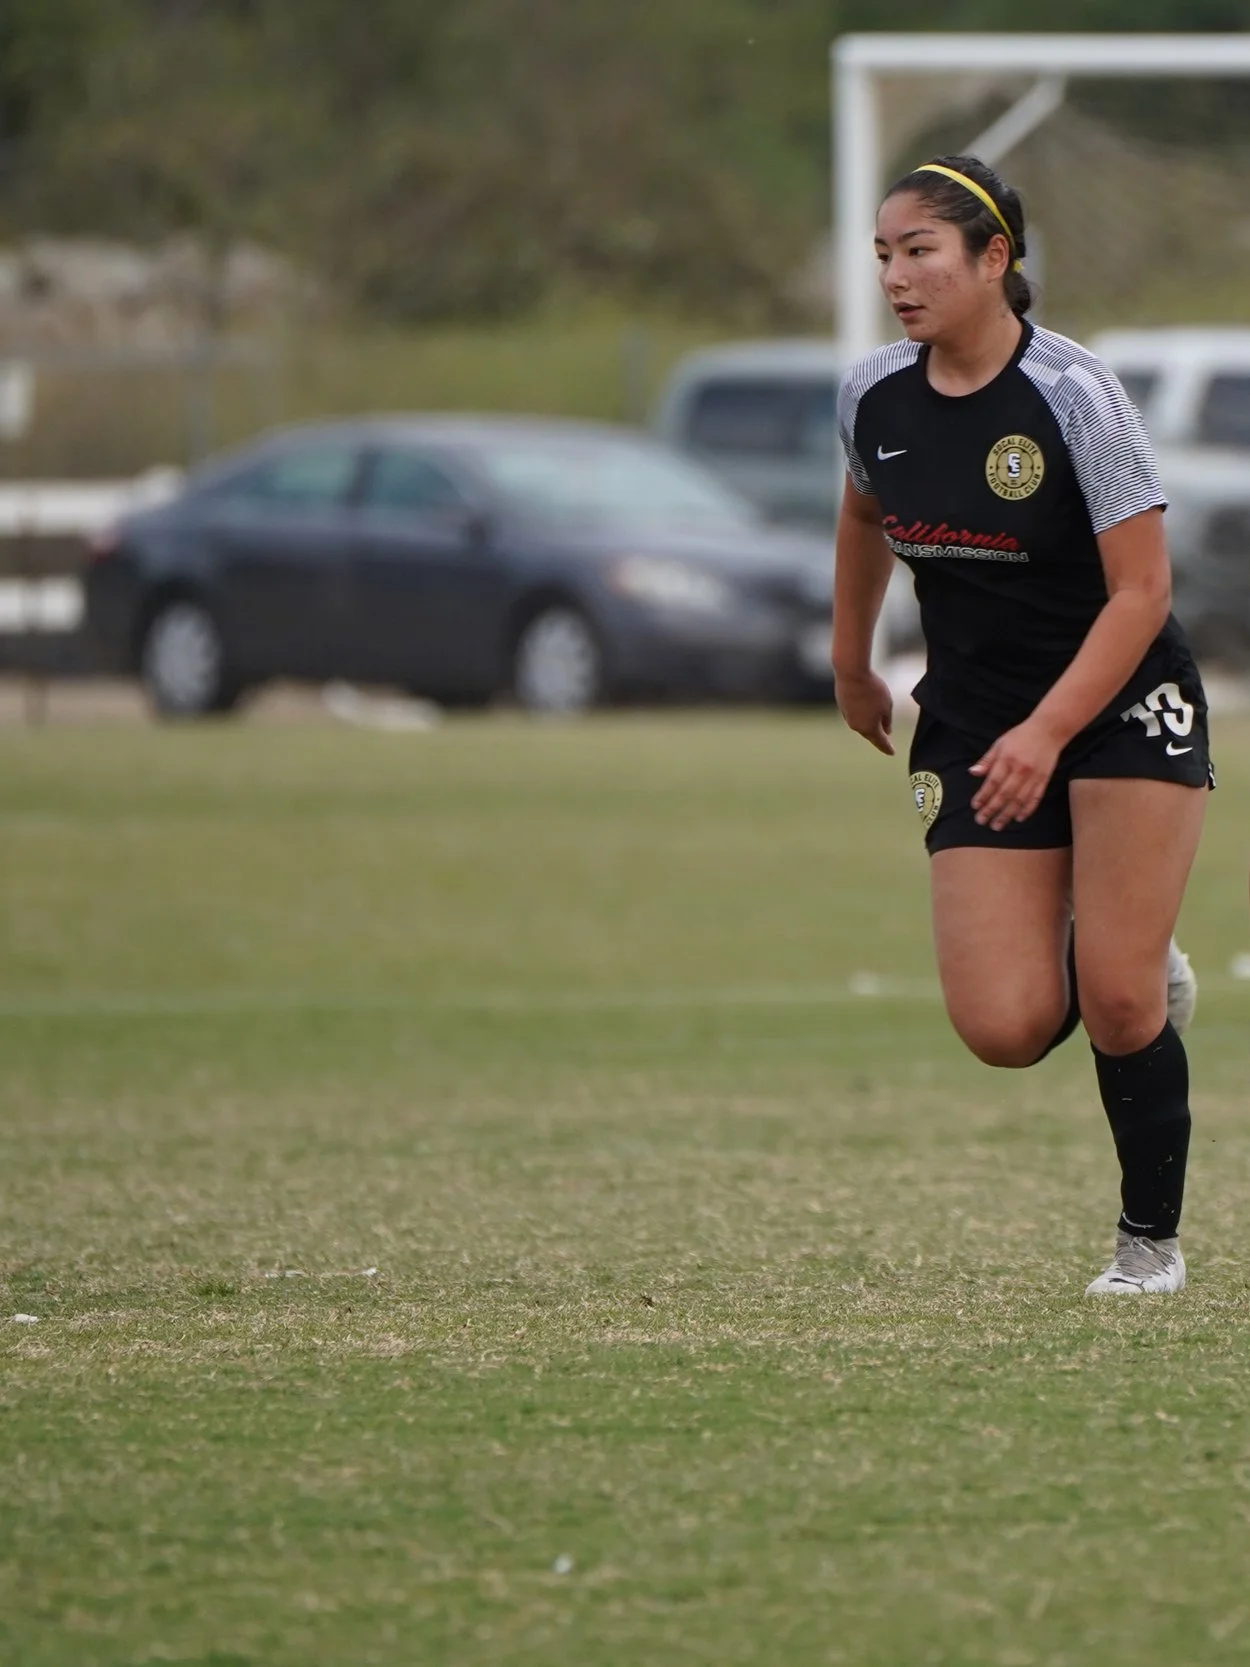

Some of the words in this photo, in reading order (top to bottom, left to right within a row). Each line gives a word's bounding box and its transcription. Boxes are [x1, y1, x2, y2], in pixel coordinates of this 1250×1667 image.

[993, 438, 1016, 455] SOCAL
[1019, 438, 1037, 456] ELITE
[989, 472, 1023, 498] FOOTBALL
[1024, 473, 1040, 494] CLUB
[883, 515, 1018, 551] California
